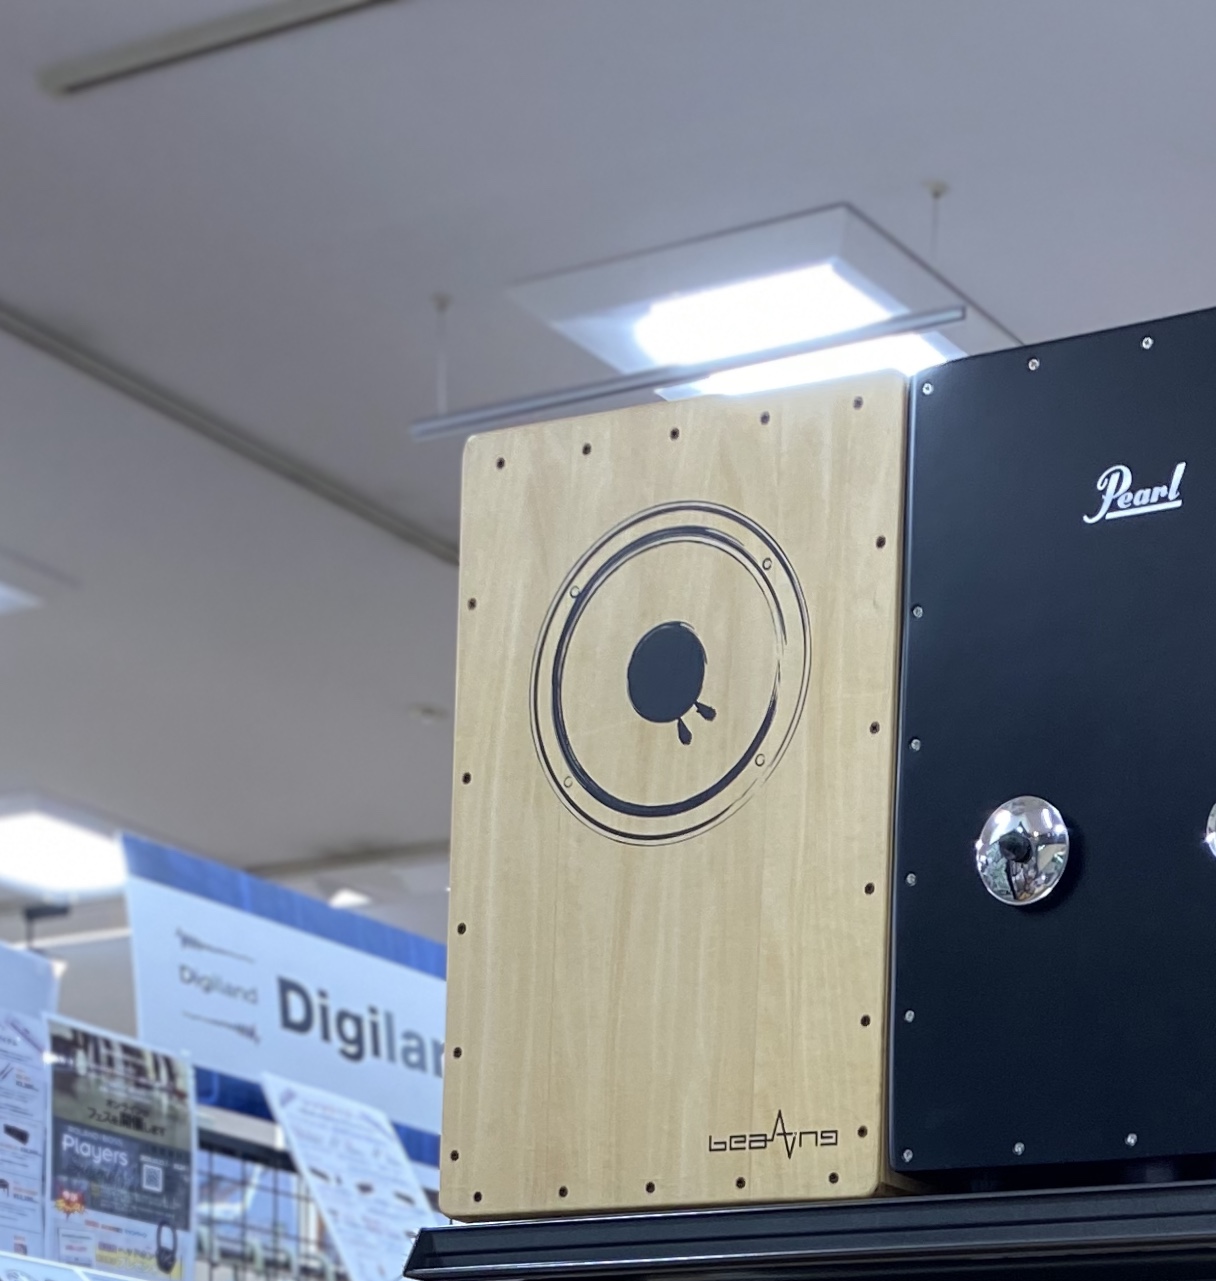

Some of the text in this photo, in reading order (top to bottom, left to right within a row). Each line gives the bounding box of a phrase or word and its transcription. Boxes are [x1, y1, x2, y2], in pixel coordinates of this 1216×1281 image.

[1083, 461, 1187, 524] Pearl
[179, 964, 258, 1004] Digiland
[62, 1133, 128, 1167] Players
